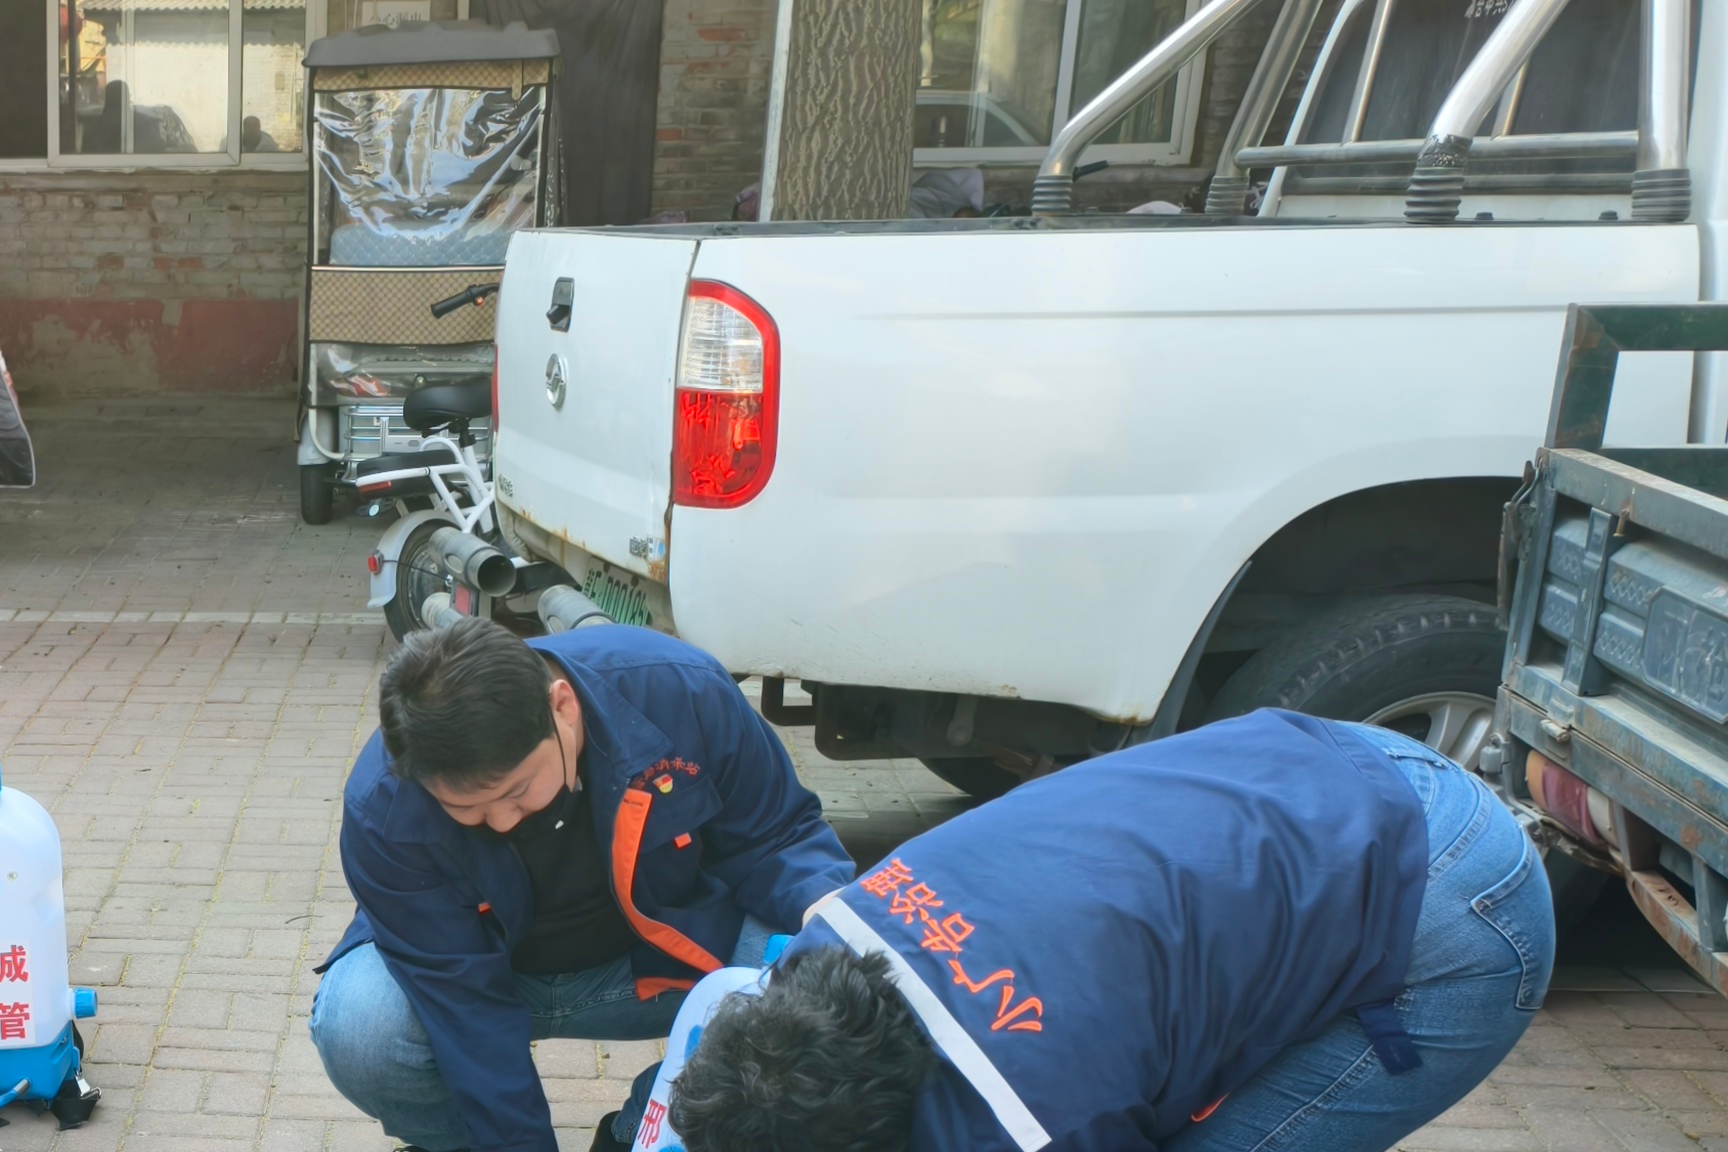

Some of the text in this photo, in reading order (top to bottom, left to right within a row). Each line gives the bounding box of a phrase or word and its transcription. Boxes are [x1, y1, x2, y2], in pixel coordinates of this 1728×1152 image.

[860, 858, 1044, 1032] 小广告治理
